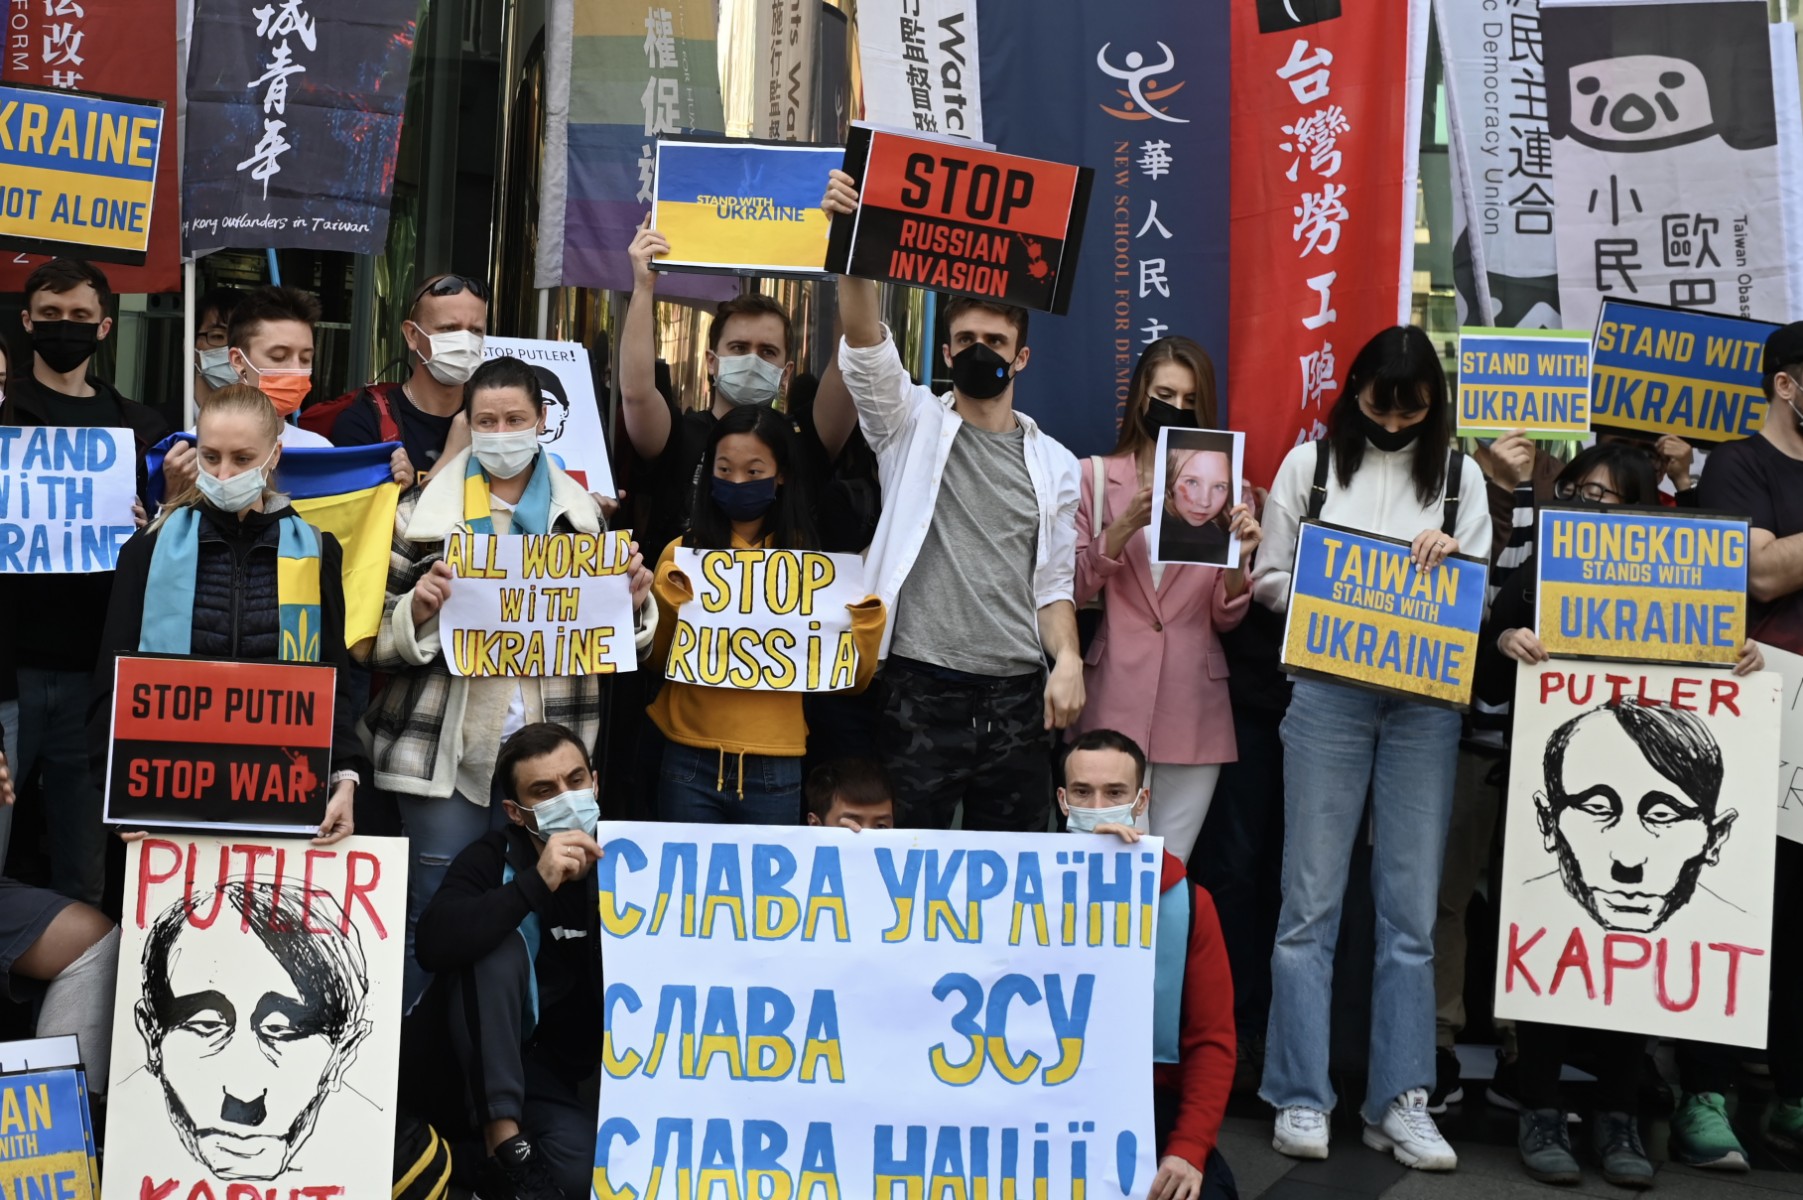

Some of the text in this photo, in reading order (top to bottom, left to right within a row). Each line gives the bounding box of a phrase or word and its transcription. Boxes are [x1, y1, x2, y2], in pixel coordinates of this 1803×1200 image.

[938, 12, 971, 139] Watc
[1481, 22, 1503, 157] Democracy
[1507, 0, 1554, 235] 民主連合
[901, 152, 1035, 225] STOP
[1114, 141, 1130, 188] NEW
[0, 186, 147, 233] OT ALONE
[697, 194, 774, 208] STAND WITH
[716, 203, 805, 222] UKRAINE
[1484, 168, 1504, 235] Union
[192, 217, 219, 236] Kong
[292, 216, 308, 228] in
[312, 217, 370, 233] Taiwan
[900, 219, 1010, 265] RUSSIAN
[1114, 195, 1130, 283] SCHOOL
[1733, 214, 1749, 267] Taiwan
[888, 250, 1010, 298] INVASION
[1115, 289, 1130, 330] FOR
[518, 348, 577, 363] PUTLER!
[1462, 351, 1588, 378] STAND WITH
[1598, 321, 1696, 363] STAND
[1463, 389, 1588, 424] UKRAINE
[1591, 372, 1768, 437] UKRAINE
[445, 529, 632, 579] ALL WORLD
[1553, 520, 1745, 568] HONGKONG
[701, 549, 836, 616] STOP
[1323, 537, 1460, 607] TAIWAN
[1582, 560, 1703, 586] STANDS WITH
[1333, 581, 1440, 623] STANDS WITH
[1560, 595, 1735, 647] UKRAINE
[1306, 611, 1466, 686] UKRAINE
[132, 682, 315, 727] STOP PUTIN
[1539, 671, 1741, 718] PUTLER
[128, 758, 309, 804] STOP WAR
[135, 838, 389, 941] PUTLER
[599, 837, 852, 944] СЛАВА
[1505, 922, 1766, 1018] KAPUT
[601, 971, 1097, 1088] СЛАВА ЗСУ
[590, 1116, 843, 1200] СЛАВА
